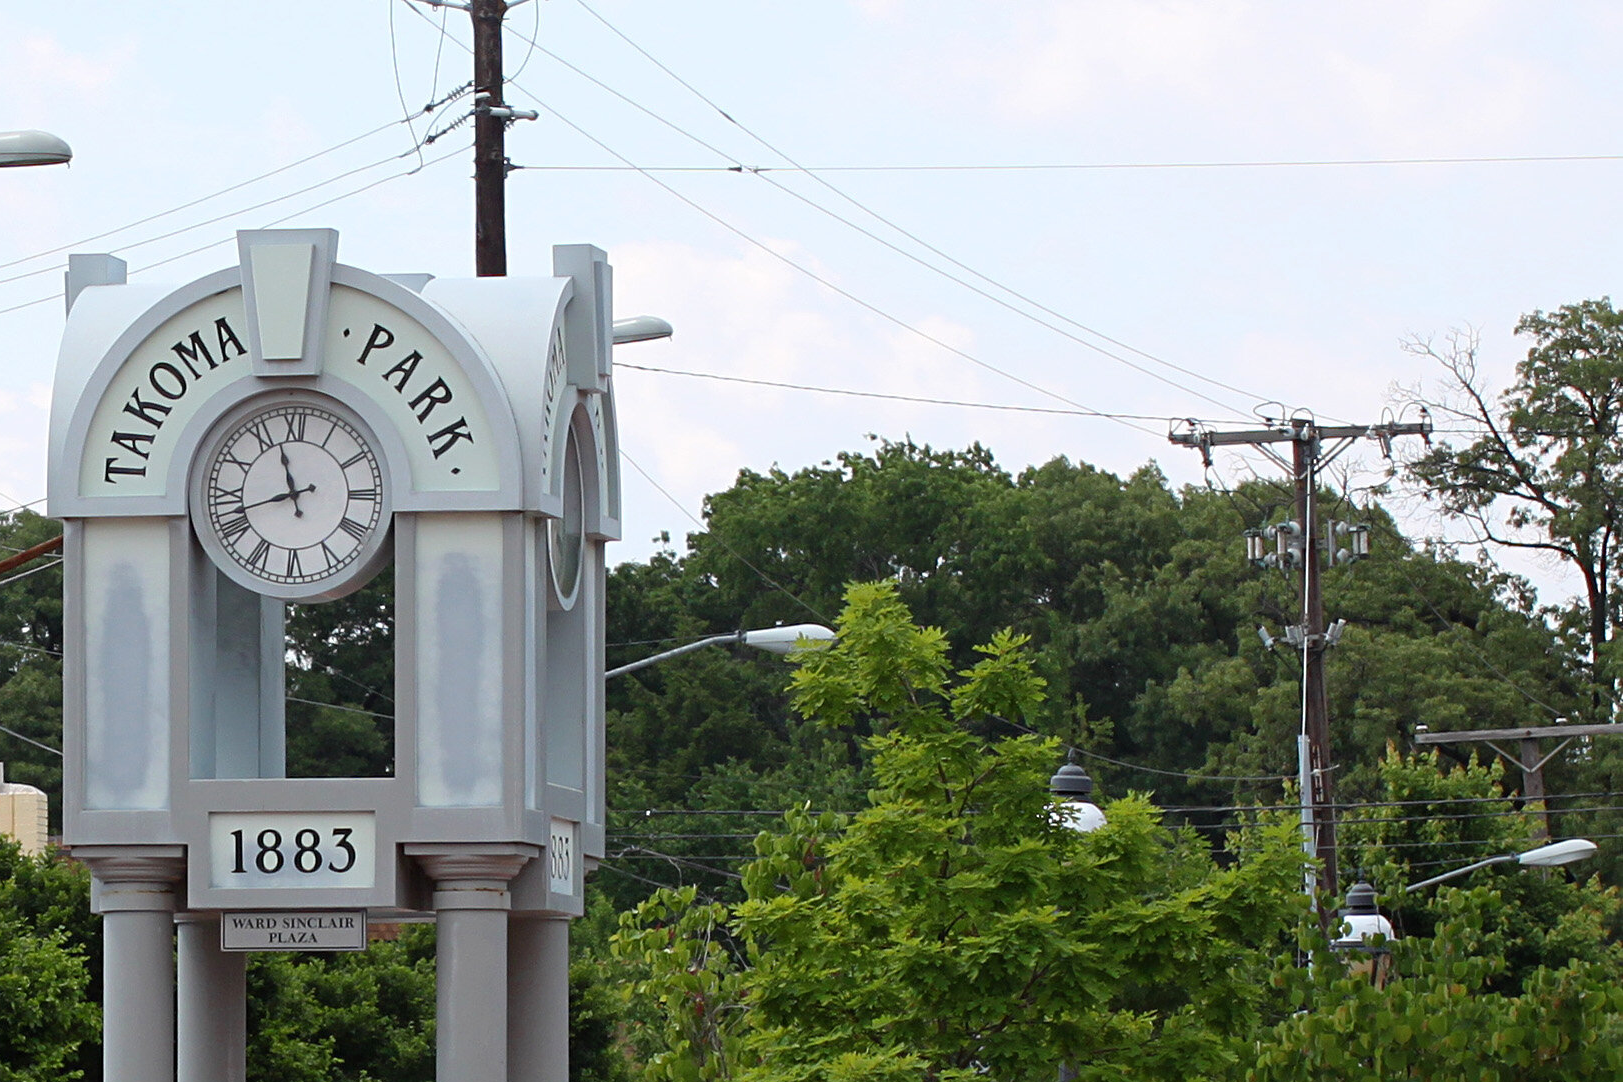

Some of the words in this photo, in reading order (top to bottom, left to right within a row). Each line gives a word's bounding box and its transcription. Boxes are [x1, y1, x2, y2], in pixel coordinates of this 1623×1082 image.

[104, 316, 248, 484] TAKOMA
[357, 323, 474, 460] PARK
[230, 828, 357, 874] 1883
[550, 834, 570, 881] 883
[233, 917, 277, 929] WARD
[282, 916, 355, 929] SINCLAIR
[268, 931, 318, 944] PLAZA
